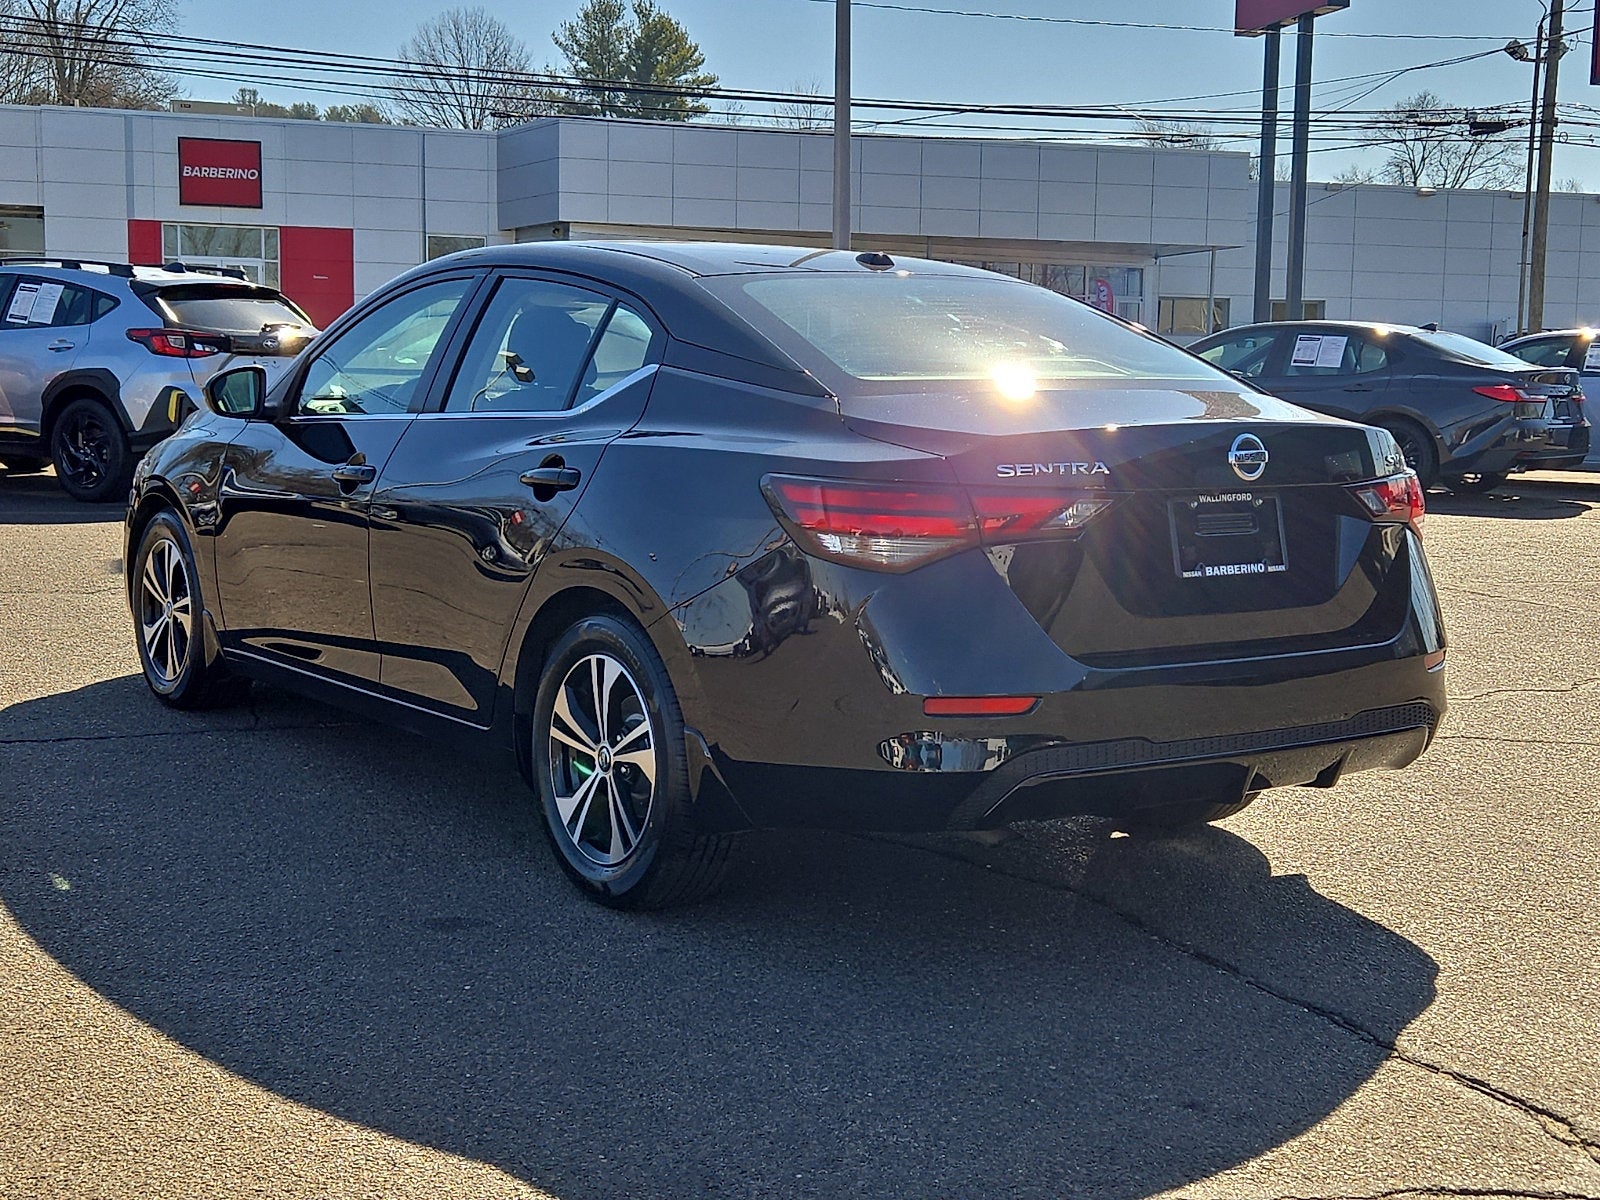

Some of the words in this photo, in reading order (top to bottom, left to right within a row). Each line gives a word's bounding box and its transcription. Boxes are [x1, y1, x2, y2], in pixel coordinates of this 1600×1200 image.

[182, 166, 259, 180] BARBERINO
[996, 461, 1110, 477] SENTRA
[1199, 493, 1252, 503] WALLINGFORD
[1205, 563, 1265, 576] BARBERINO
